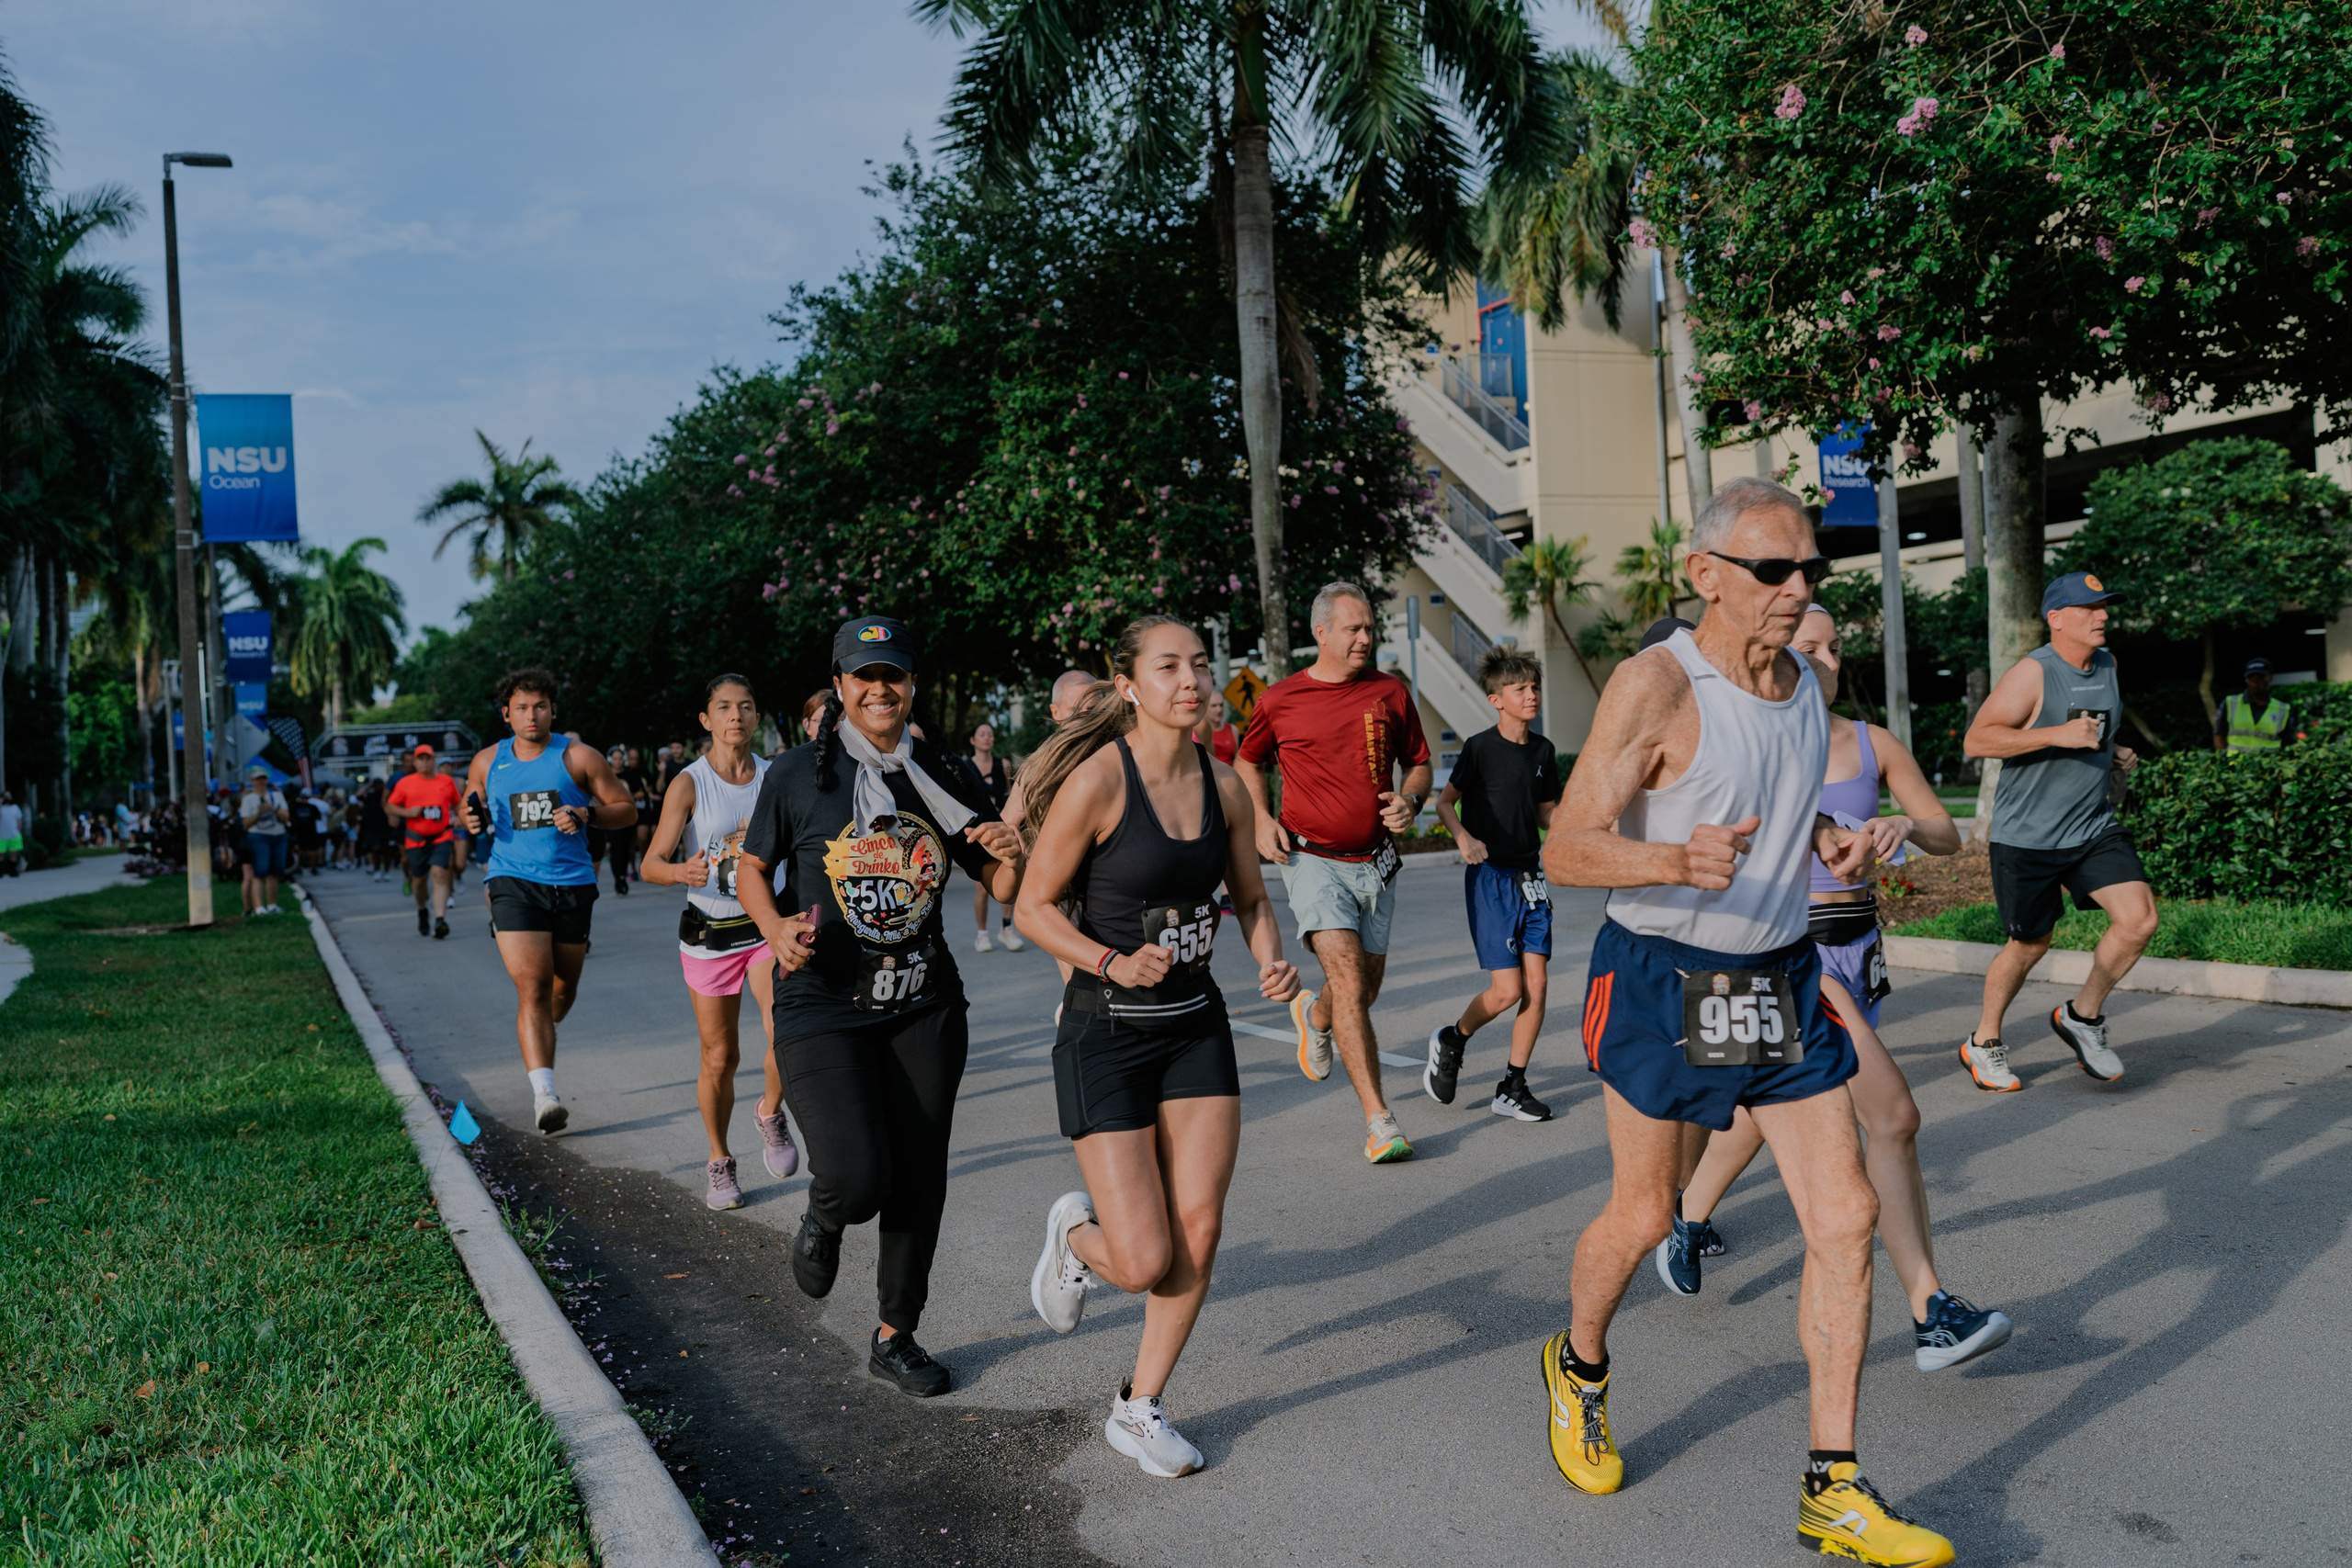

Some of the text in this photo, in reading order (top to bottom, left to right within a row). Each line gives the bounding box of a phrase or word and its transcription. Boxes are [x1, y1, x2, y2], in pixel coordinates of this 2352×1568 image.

[207, 446, 287, 473] NSU
[209, 474, 260, 490] Ocean
[1824, 476, 1871, 488] Research
[228, 636, 268, 651] NSU
[1363, 712, 1379, 785] ELEMENTARY
[517, 800, 554, 822] 792
[850, 837, 898, 855] Cinco
[874, 851, 884, 859] de
[852, 860, 900, 874] Drinko
[1377, 842, 1397, 878] 695
[860, 879, 897, 911] 5K
[1194, 904, 1210, 919] 5K
[846, 908, 882, 941] Margarita
[883, 930, 902, 941] Mile
[1159, 917, 1213, 966] 655
[907, 951, 923, 964] 5K
[872, 963, 928, 1001] 876
[1751, 976, 1771, 992] 5K
[1700, 996, 1784, 1044] 955
